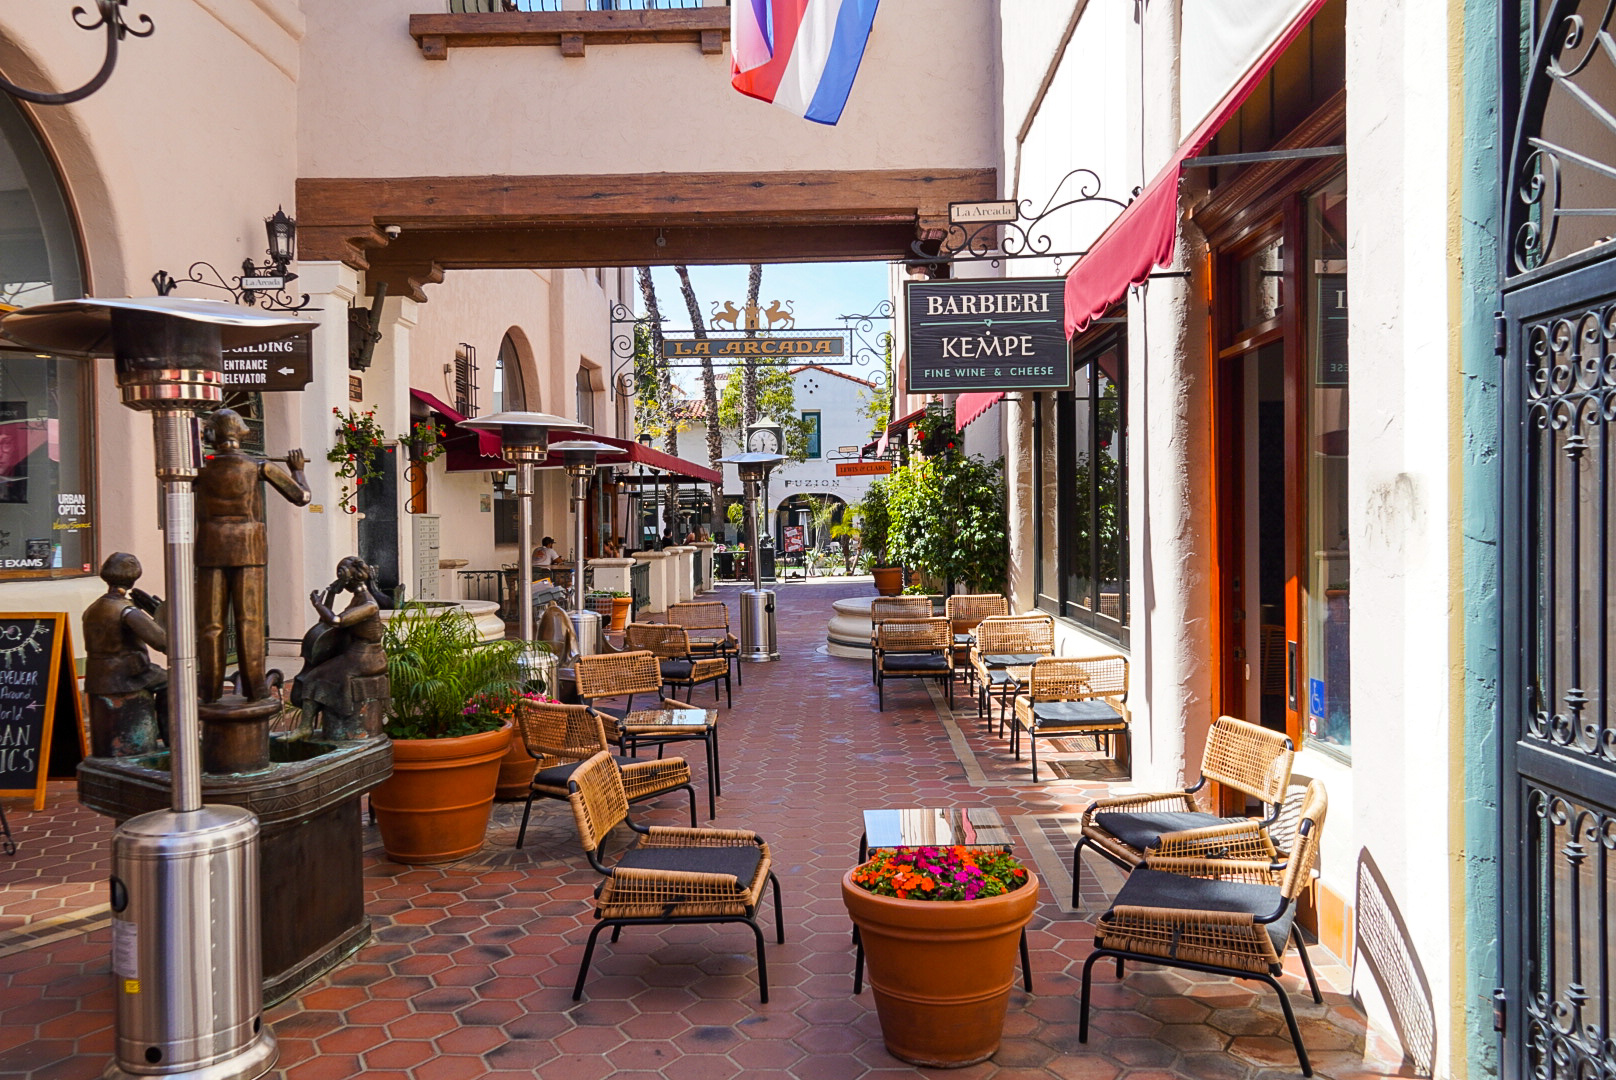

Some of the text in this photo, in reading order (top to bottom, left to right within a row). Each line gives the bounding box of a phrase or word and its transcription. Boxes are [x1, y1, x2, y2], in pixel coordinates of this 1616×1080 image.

[956, 205, 1011, 217] La Arcada
[926, 293, 1050, 315] BARBIERI
[674, 340, 832, 355] LA ARCADA
[941, 335, 1035, 359] KEMPE
[223, 359, 268, 371] ENTRANCE
[924, 366, 1054, 378] FINE WINE & CHEESE
[224, 373, 267, 384] ELEVATOR
[784, 479, 840, 488] FUZION
[57, 493, 86, 504] URBAN
[57, 505, 86, 515] OPTICS
[5, 558, 43, 568] EXAMS
[0, 670, 38, 686] EYEWEAR
[0, 703, 24, 721] orld
[0, 724, 31, 747] AN
